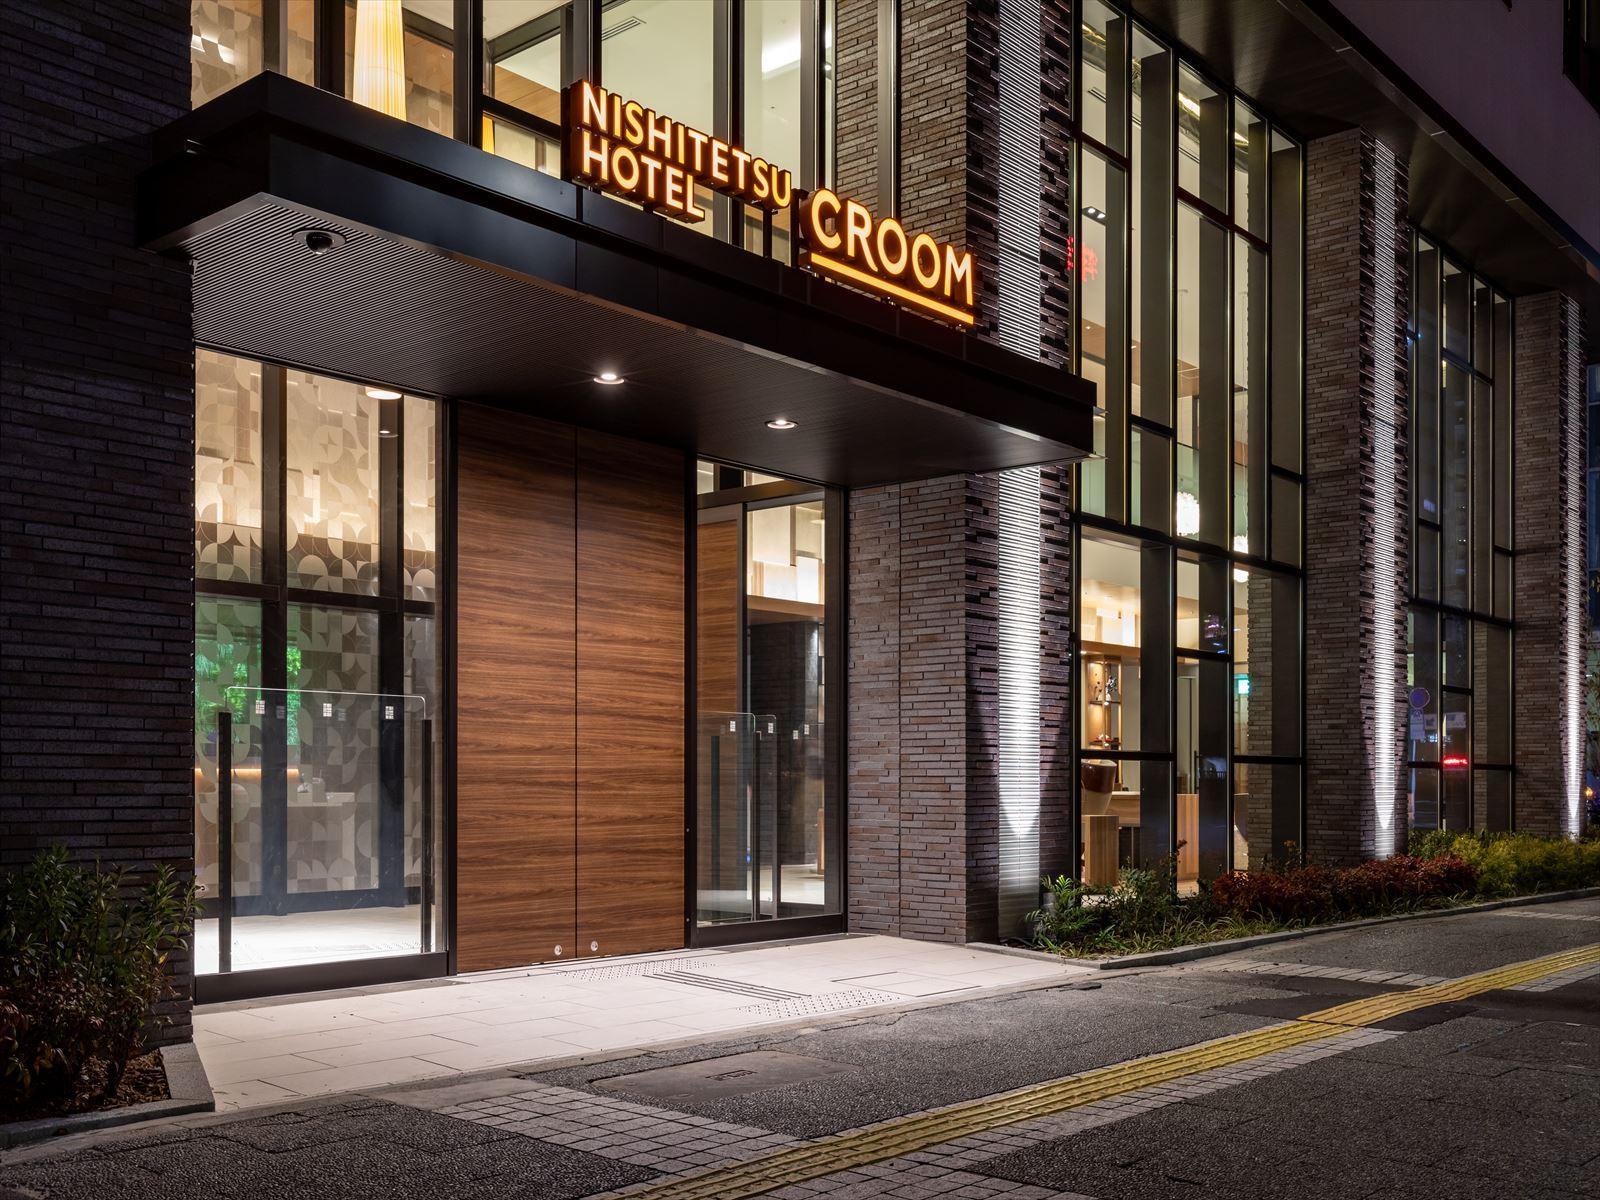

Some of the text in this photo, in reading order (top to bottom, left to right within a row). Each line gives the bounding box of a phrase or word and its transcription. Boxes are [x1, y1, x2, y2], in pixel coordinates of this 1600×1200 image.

[582, 81, 791, 207] NISHITETSU
[582, 130, 704, 219] HOTEL
[811, 188, 973, 305] CROOM
